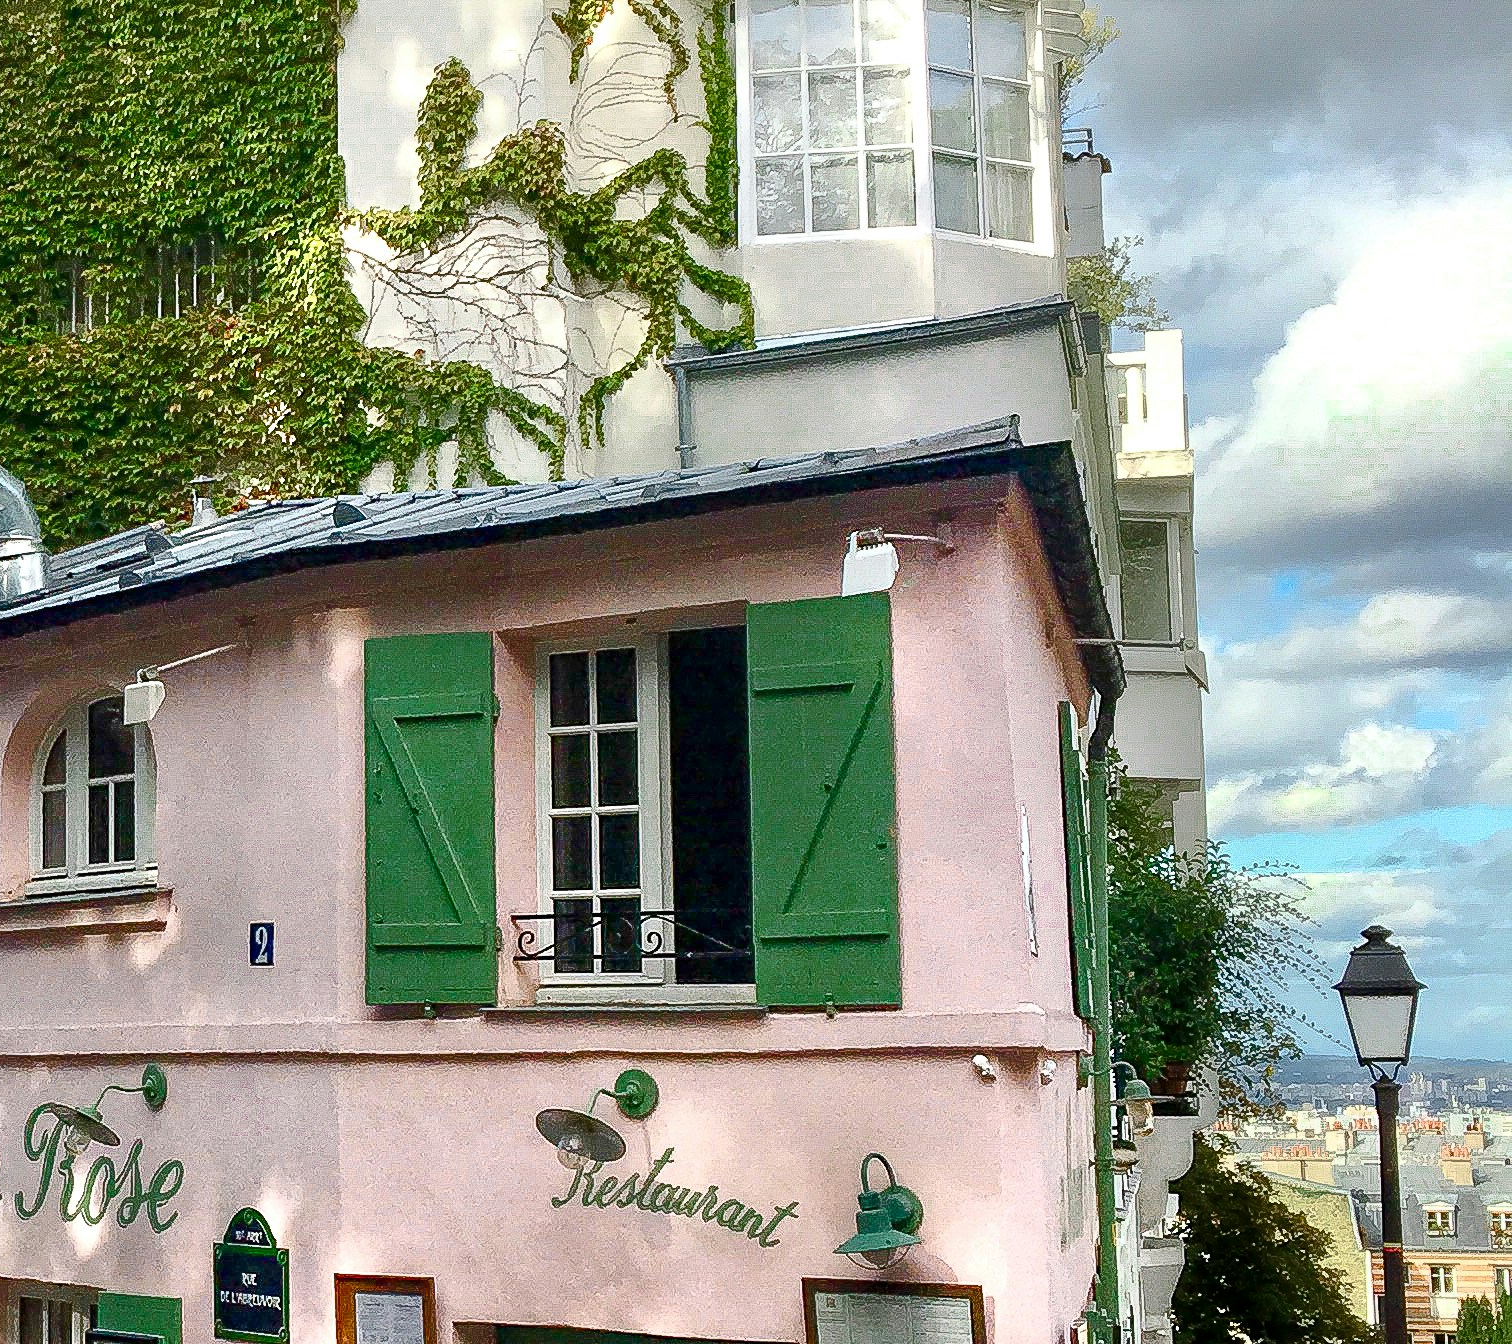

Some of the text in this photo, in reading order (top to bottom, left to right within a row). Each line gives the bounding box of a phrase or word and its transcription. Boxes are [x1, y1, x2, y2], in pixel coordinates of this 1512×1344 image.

[255, 926, 268, 964] 2
[15, 1102, 186, 1234] Rose
[551, 1146, 800, 1248] Restaurant
[220, 1290, 230, 1303] DE
[241, 1272, 258, 1287] RUE
